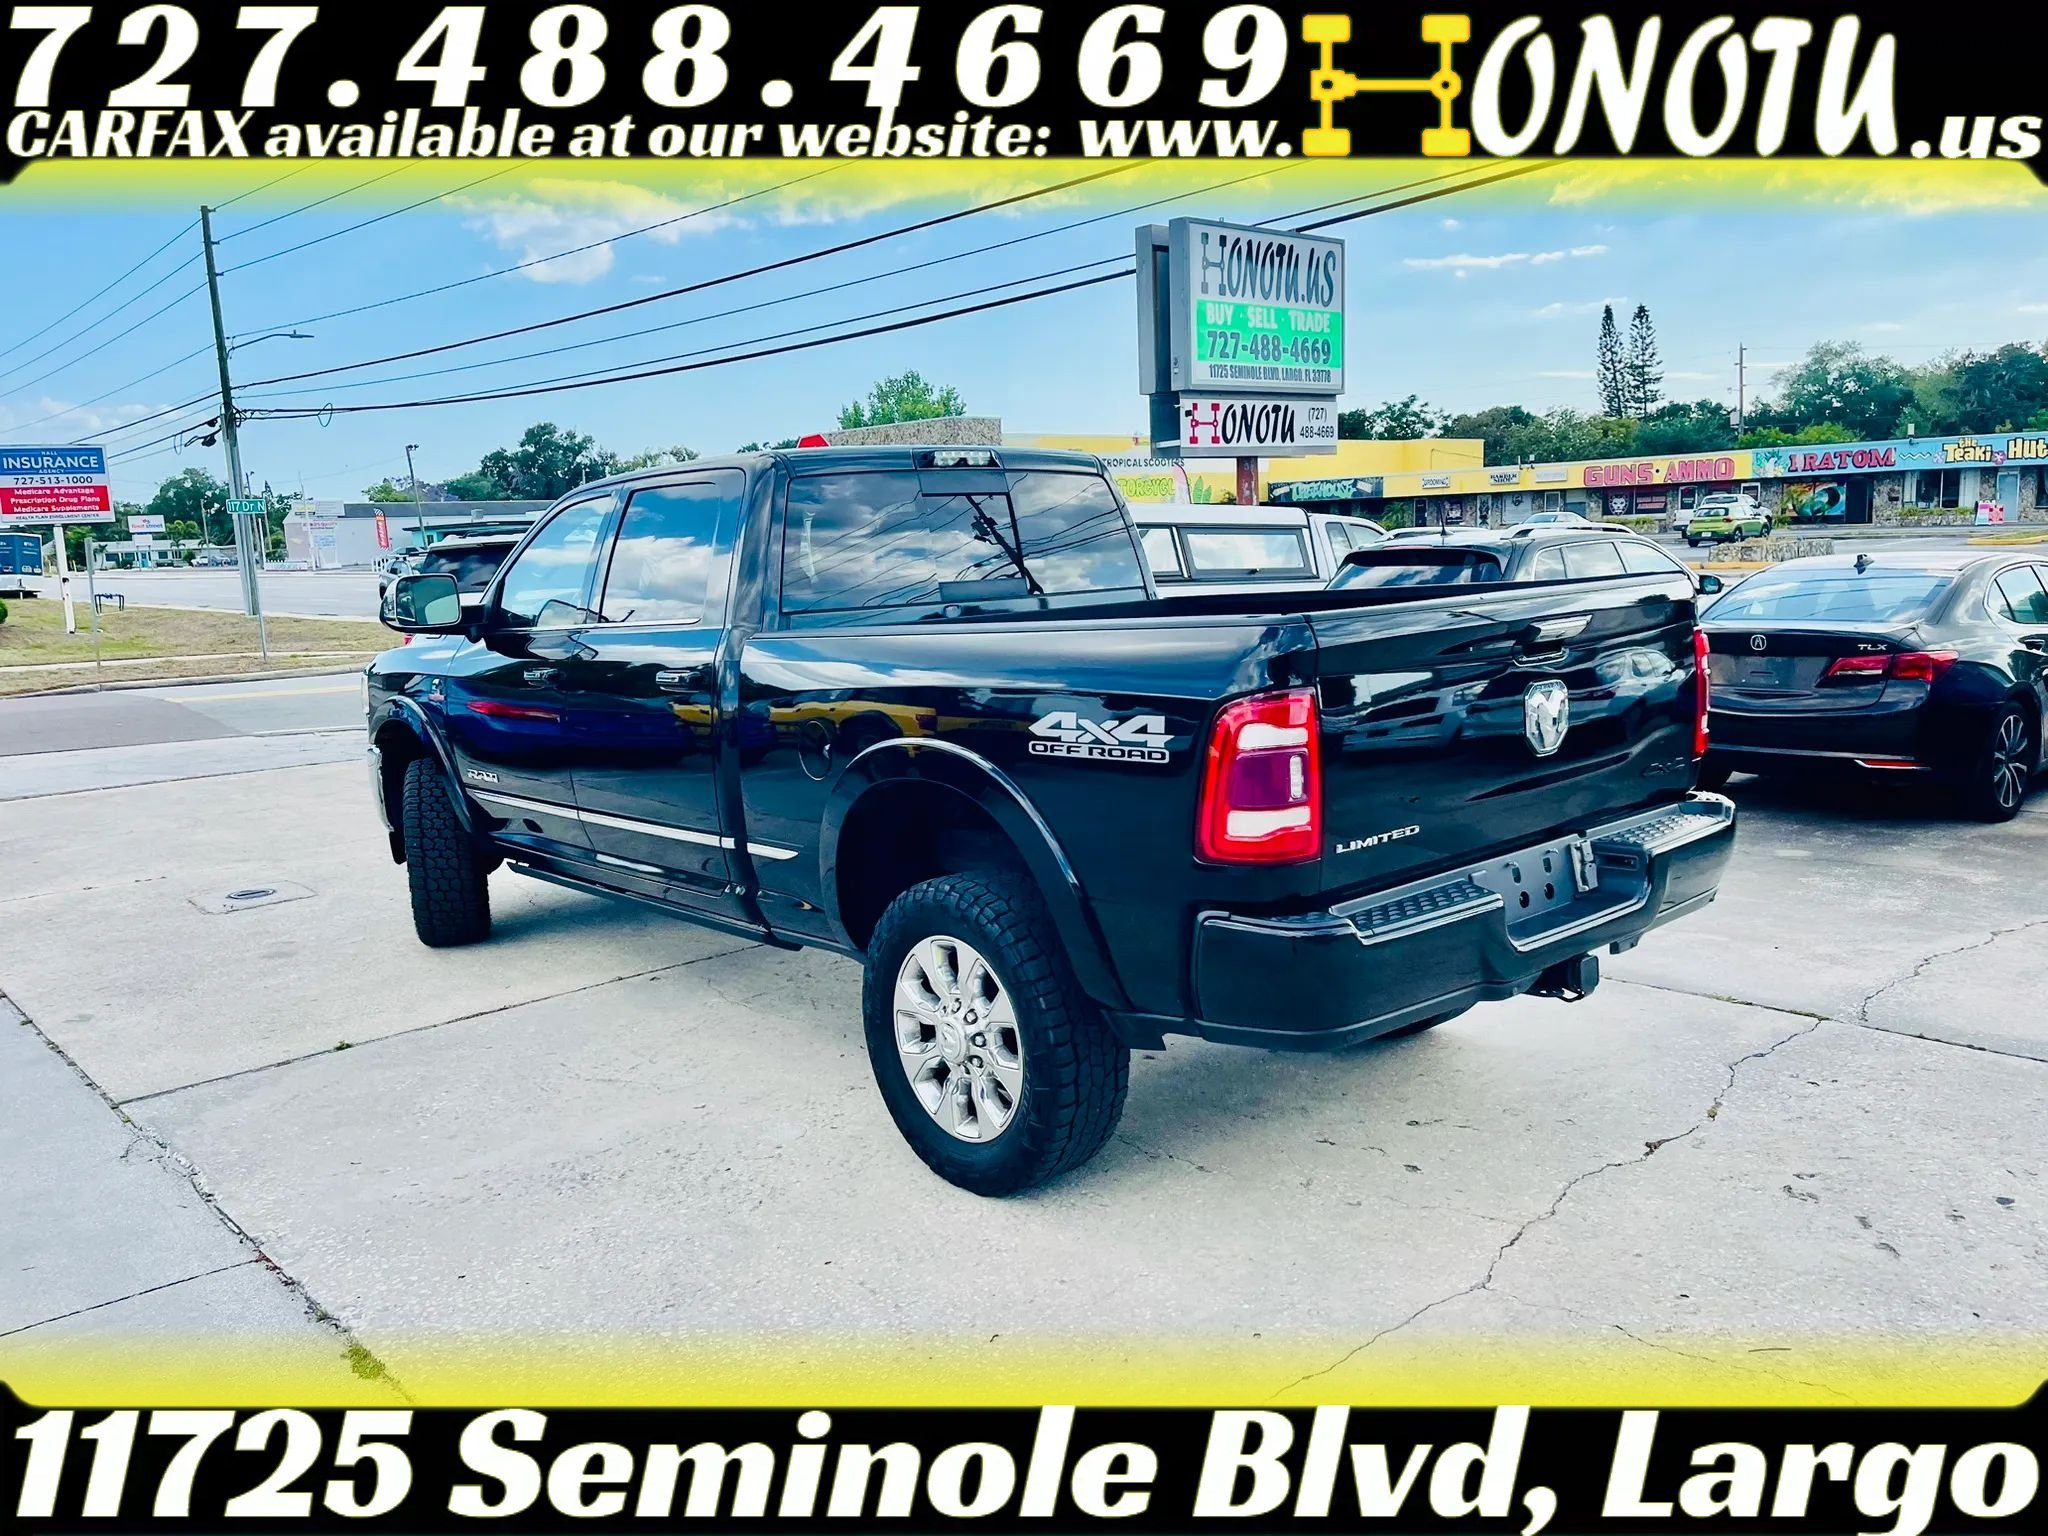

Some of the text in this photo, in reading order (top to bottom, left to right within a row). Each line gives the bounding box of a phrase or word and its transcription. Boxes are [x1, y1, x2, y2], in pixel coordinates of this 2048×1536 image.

[1206, 303, 1331, 333] BUY SELL TRADE
[1207, 330, 1331, 365] 727-488-4669
[1209, 364, 1229, 379] 11725
[1229, 365, 1262, 380] SEMINOLE
[1304, 368, 1311, 382] FL
[1308, 407, 1328, 421] (727)
[1189, 402, 1295, 444] HONOTU
[1300, 425, 1335, 438] 488-4669
[1958, 437, 1980, 447] the
[2007, 437, 2048, 460] Hut
[3, 456, 99, 469] INSURANCE
[1102, 458, 1185, 467] TROPICAL SCOOTERS
[1584, 463, 1653, 487] GUNS
[1664, 457, 1735, 482] AMMO
[14, 475, 93, 485] 727-513-1000
[14, 487, 95, 496] Medicare Advantage
[10, 497, 57, 505] Prescription
[59, 496, 78, 504] Drug
[228, 501, 266, 512] 117 Dr N
[14, 504, 100, 513] Medicare Supplements
[1857, 643, 1887, 651] TLX
[1028, 711, 1175, 748] 4x4
[1031, 743, 1167, 761] OFF ROAD
[467, 768, 499, 783] RAM
[1336, 825, 1420, 855] LIMITED
